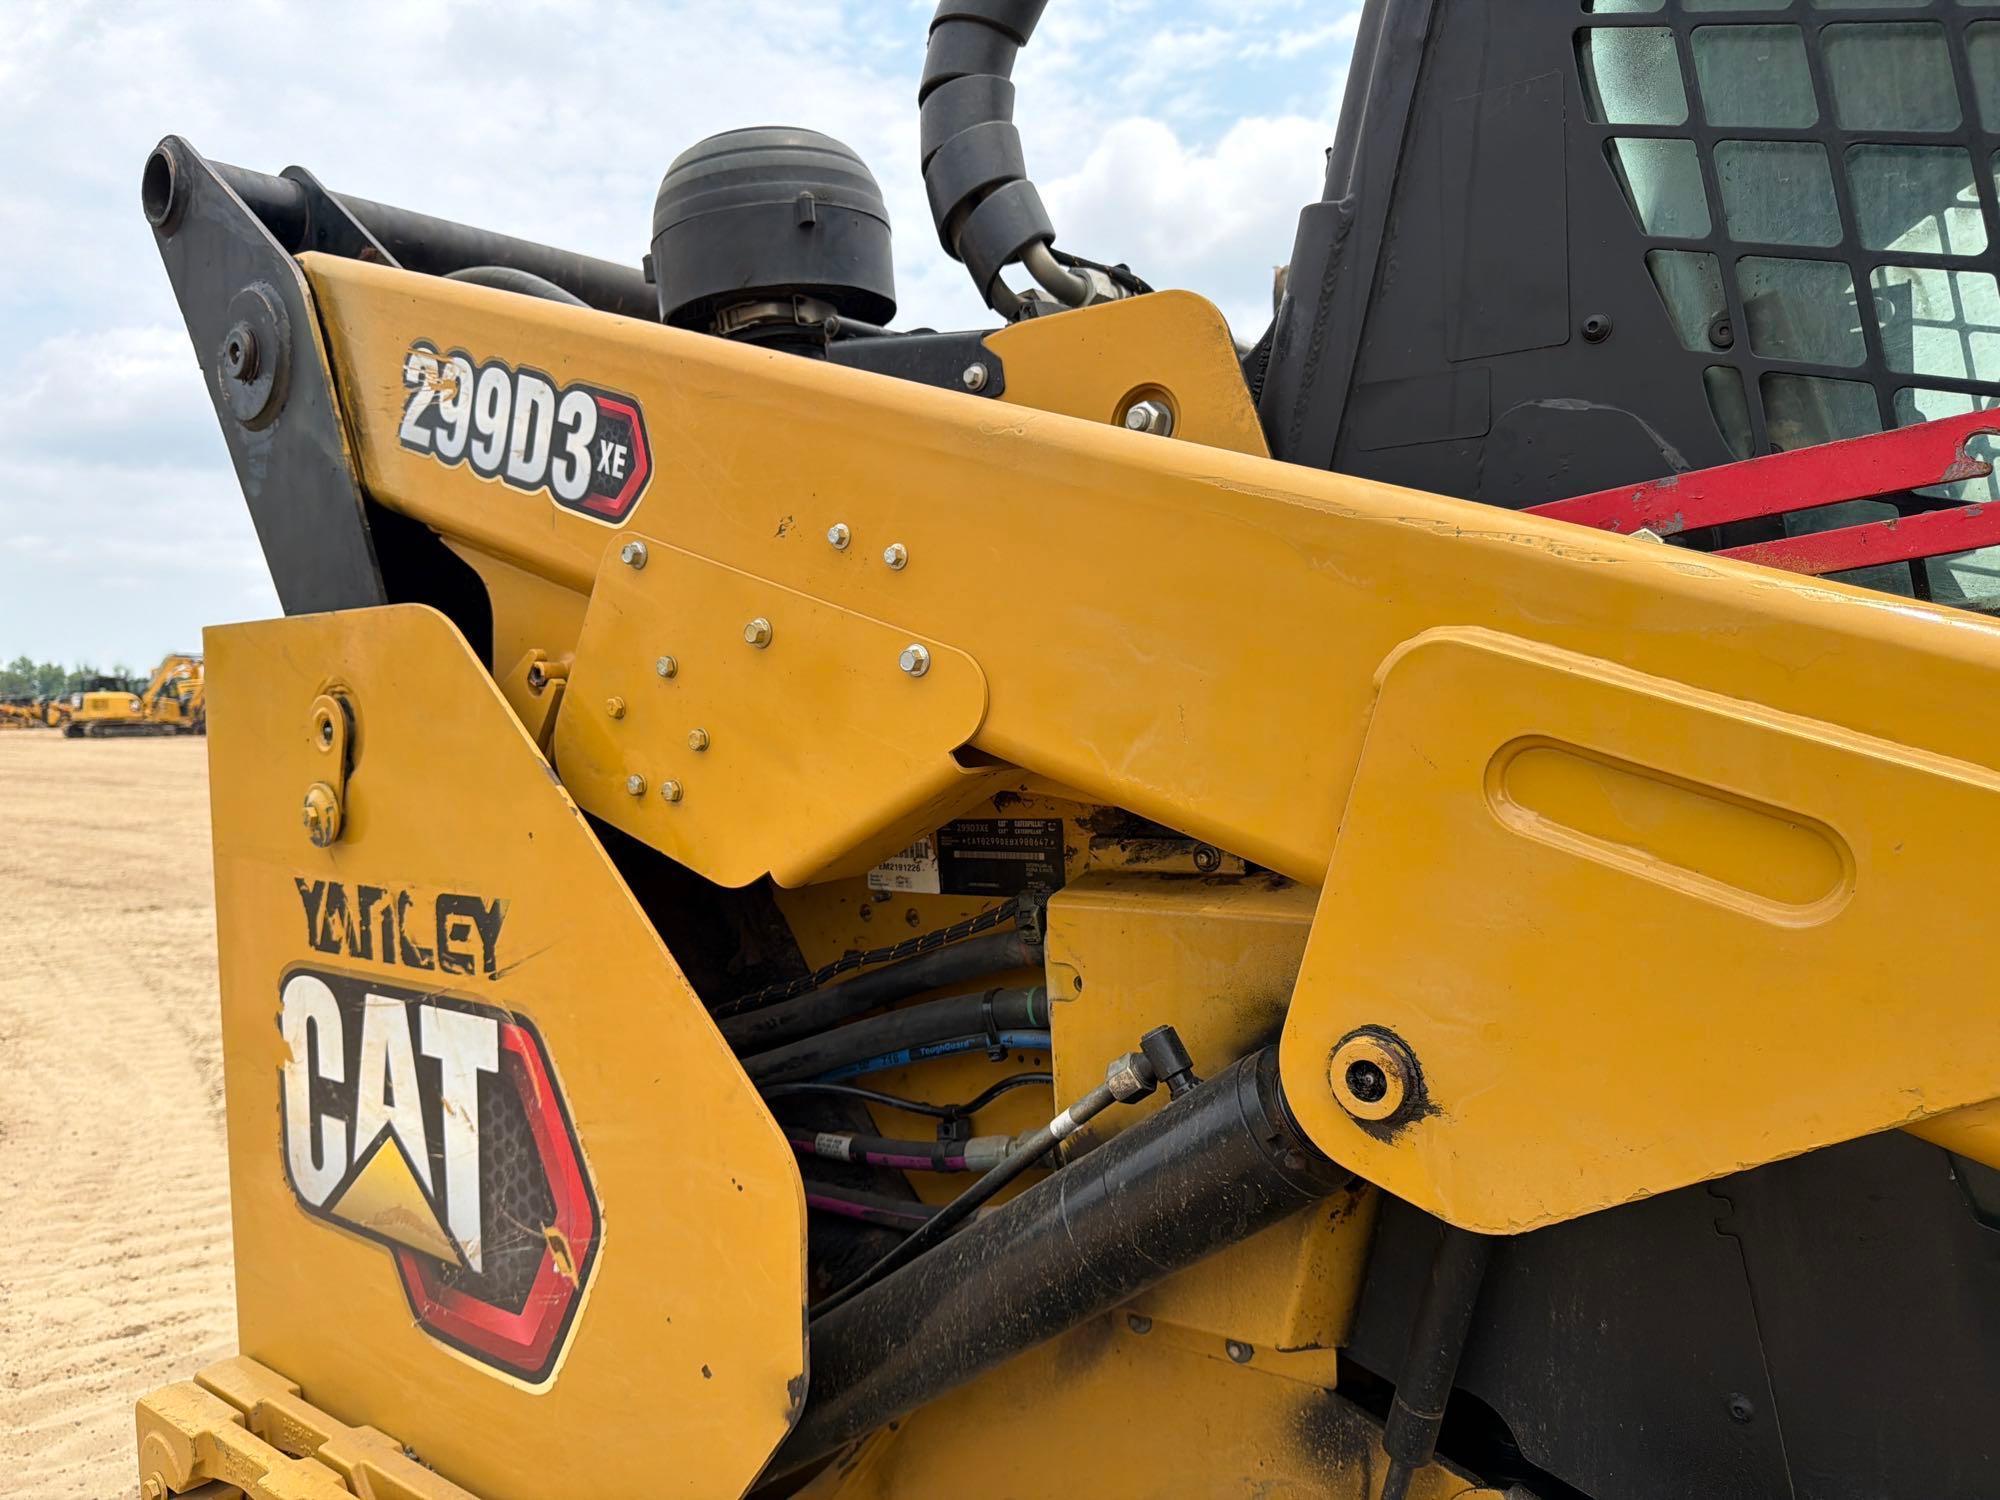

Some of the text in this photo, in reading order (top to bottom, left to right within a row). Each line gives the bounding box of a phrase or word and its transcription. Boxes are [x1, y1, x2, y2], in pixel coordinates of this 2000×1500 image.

[399, 346, 628, 501] 299D3 XE
[282, 974, 500, 1275] CAT
